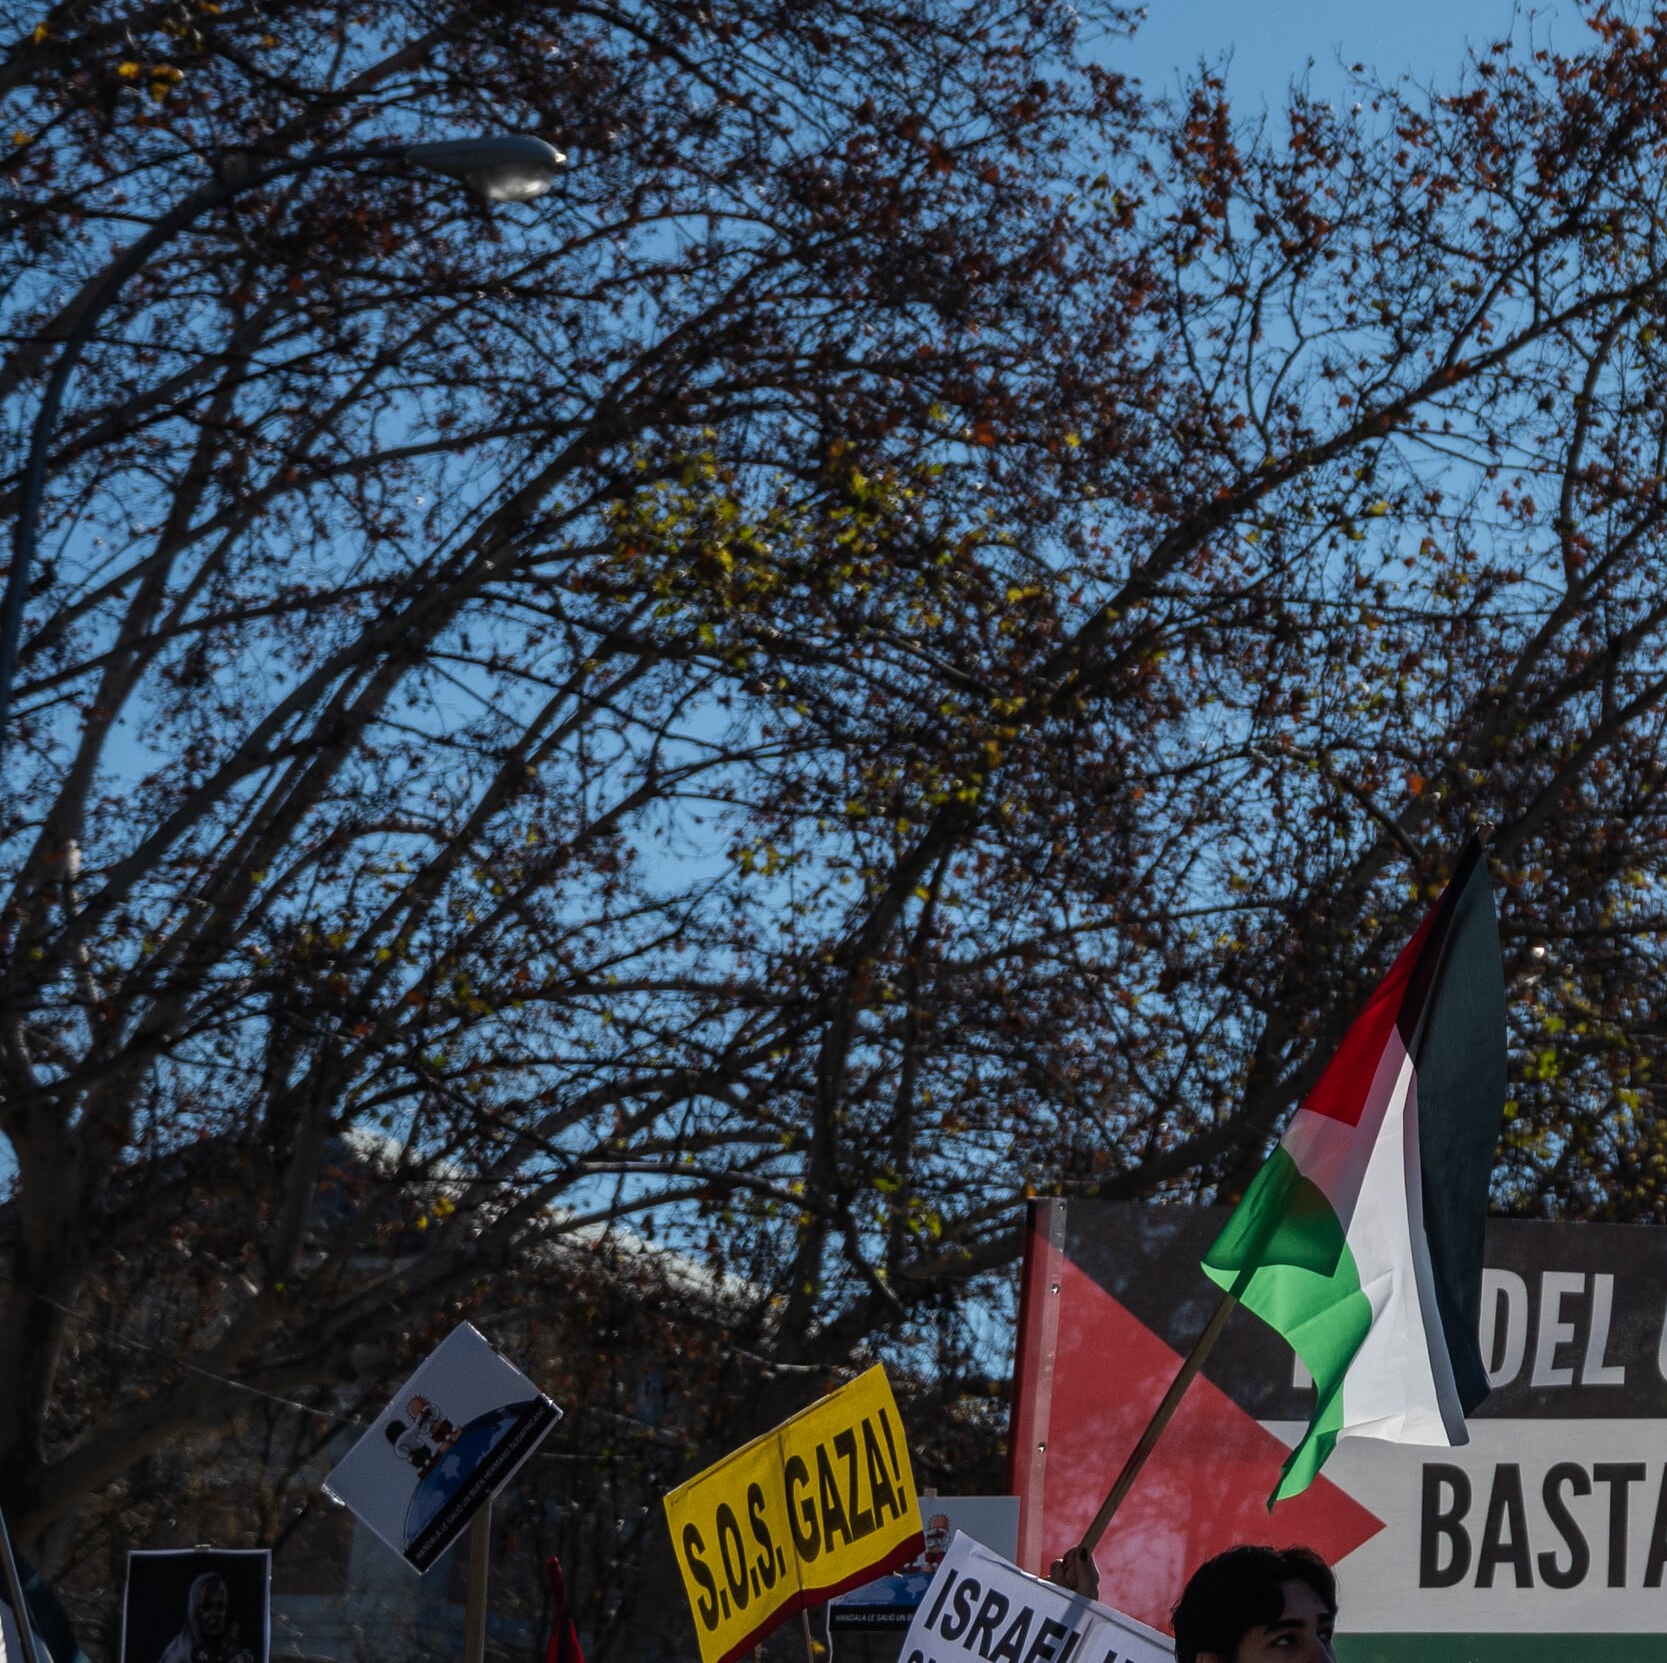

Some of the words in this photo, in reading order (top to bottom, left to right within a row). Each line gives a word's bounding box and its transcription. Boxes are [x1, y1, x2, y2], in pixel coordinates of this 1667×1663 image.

[1479, 1267, 1625, 1389] DEL
[682, 1482, 786, 1631] S.O.S.
[785, 1408, 908, 1563] GAZA!
